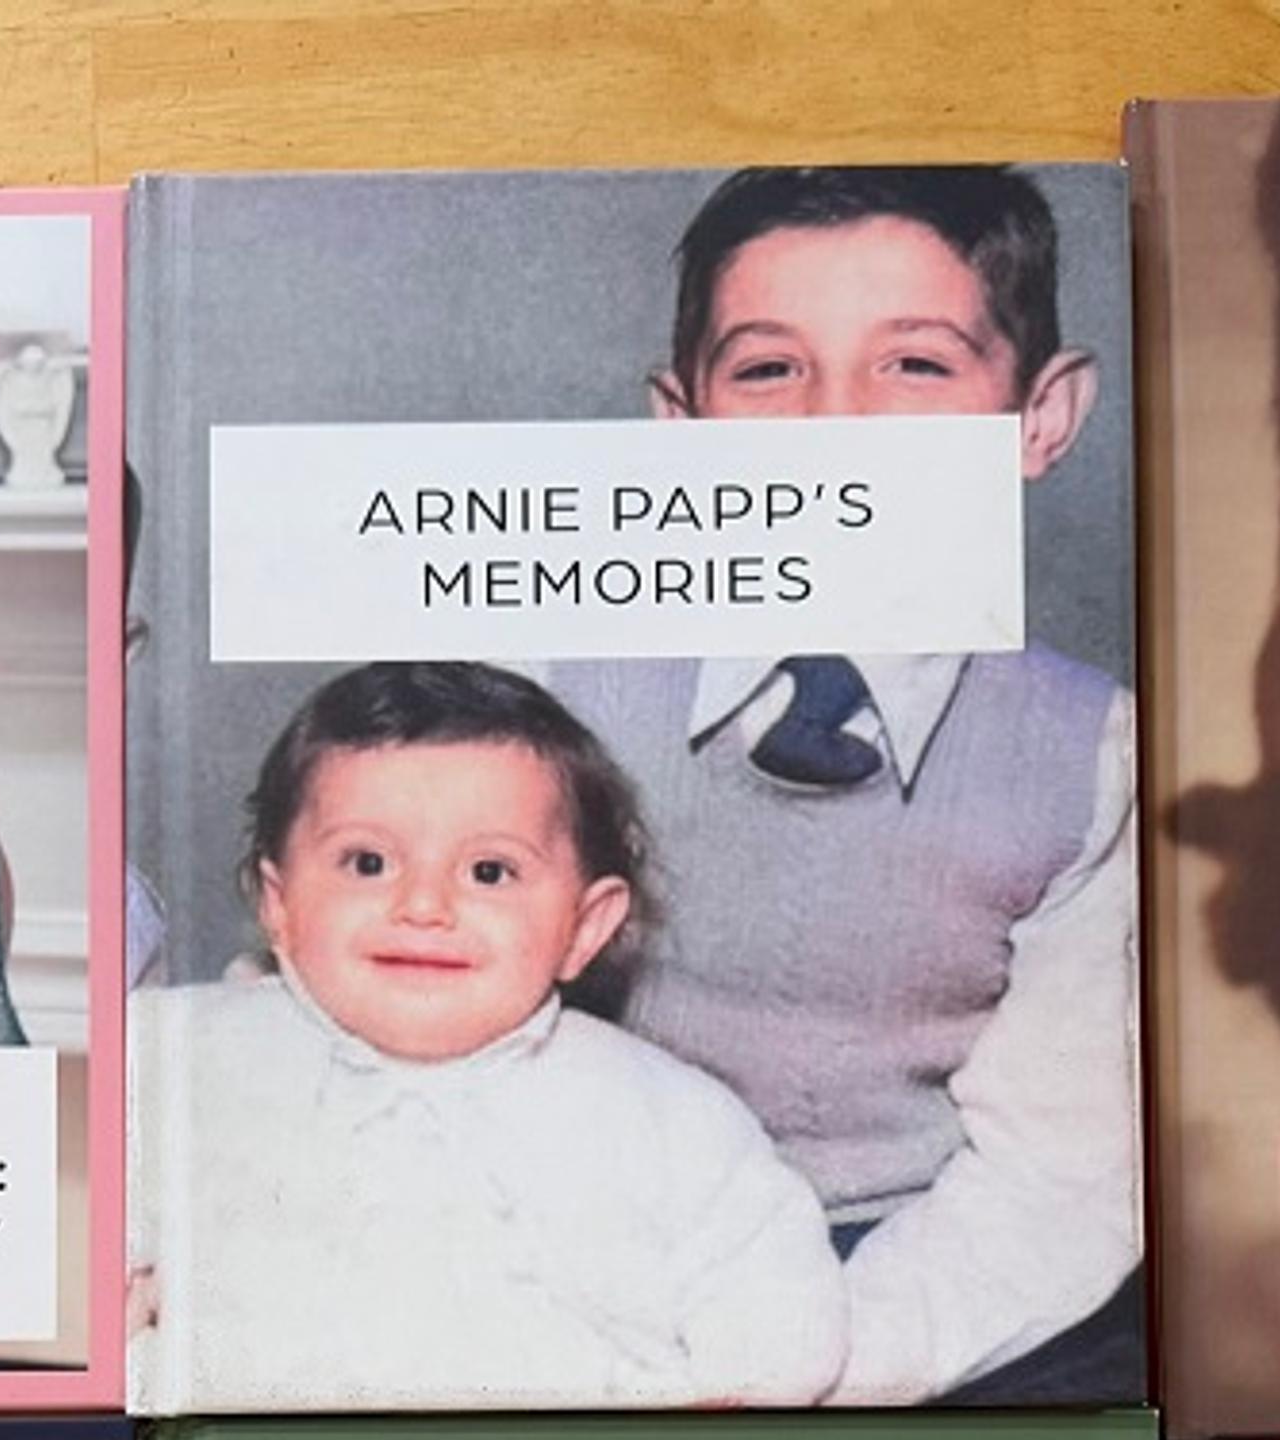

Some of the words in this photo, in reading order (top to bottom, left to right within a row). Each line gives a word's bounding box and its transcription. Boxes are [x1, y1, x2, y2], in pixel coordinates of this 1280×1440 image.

[360, 488, 579, 534] ARNIE
[614, 484, 872, 530] PAPP'S
[425, 557, 811, 606] MEMORIES
